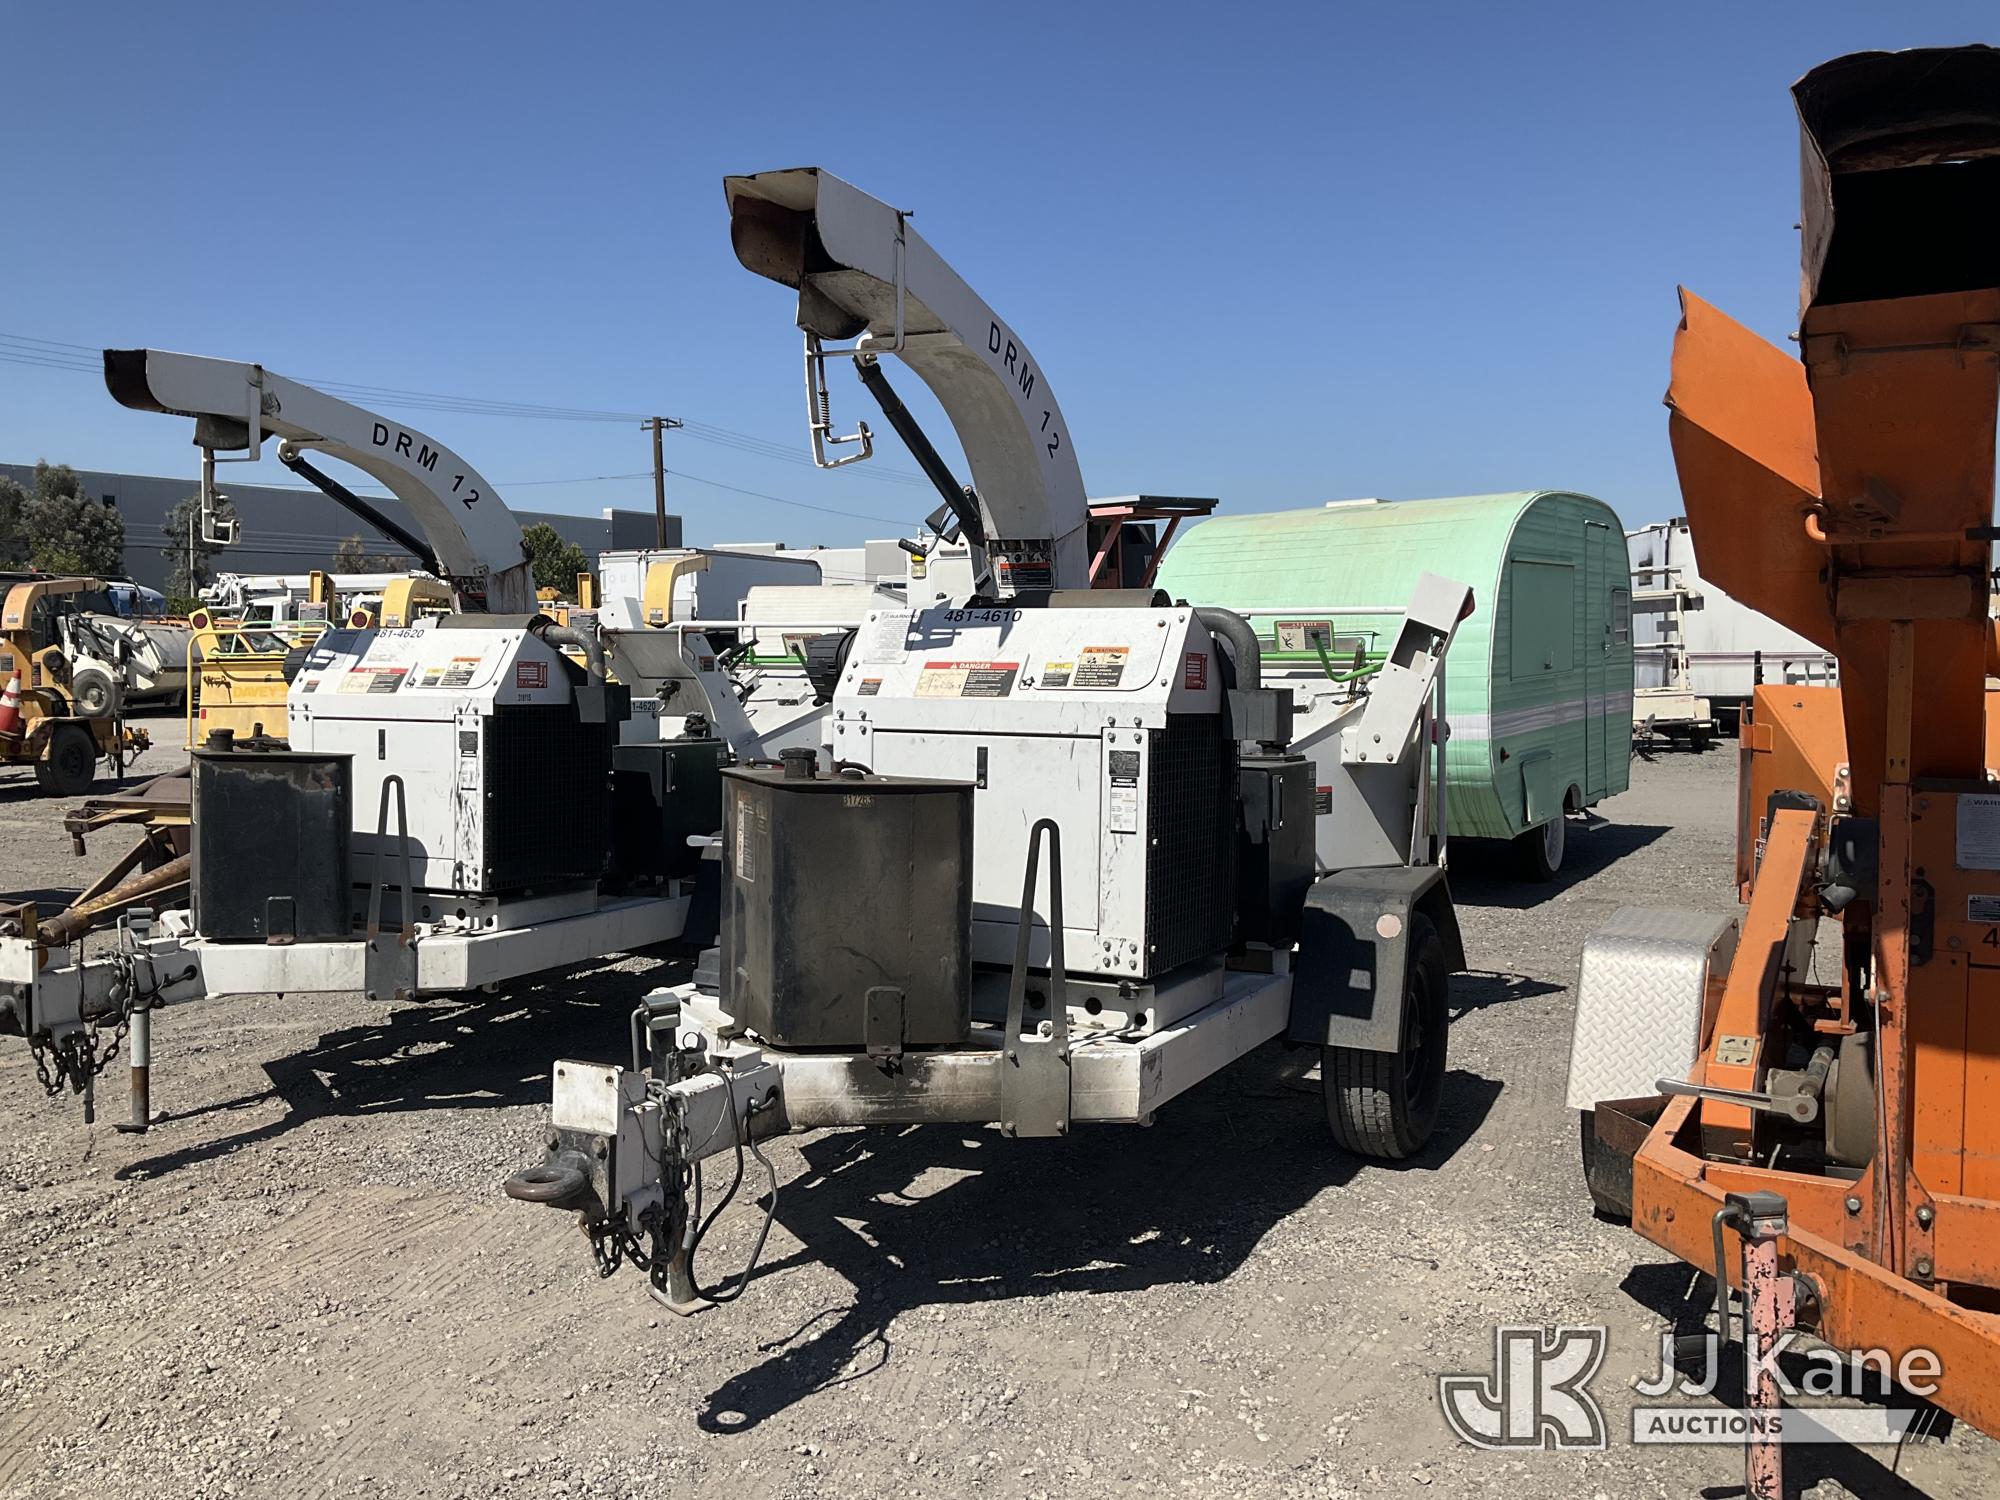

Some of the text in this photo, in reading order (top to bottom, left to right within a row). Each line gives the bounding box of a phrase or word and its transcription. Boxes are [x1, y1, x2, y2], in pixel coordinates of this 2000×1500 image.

[988, 321, 1060, 459] DRM 12
[372, 423, 480, 510] DRM 12
[374, 629, 424, 638] 481-4620
[944, 610, 1022, 623] 481-4610
